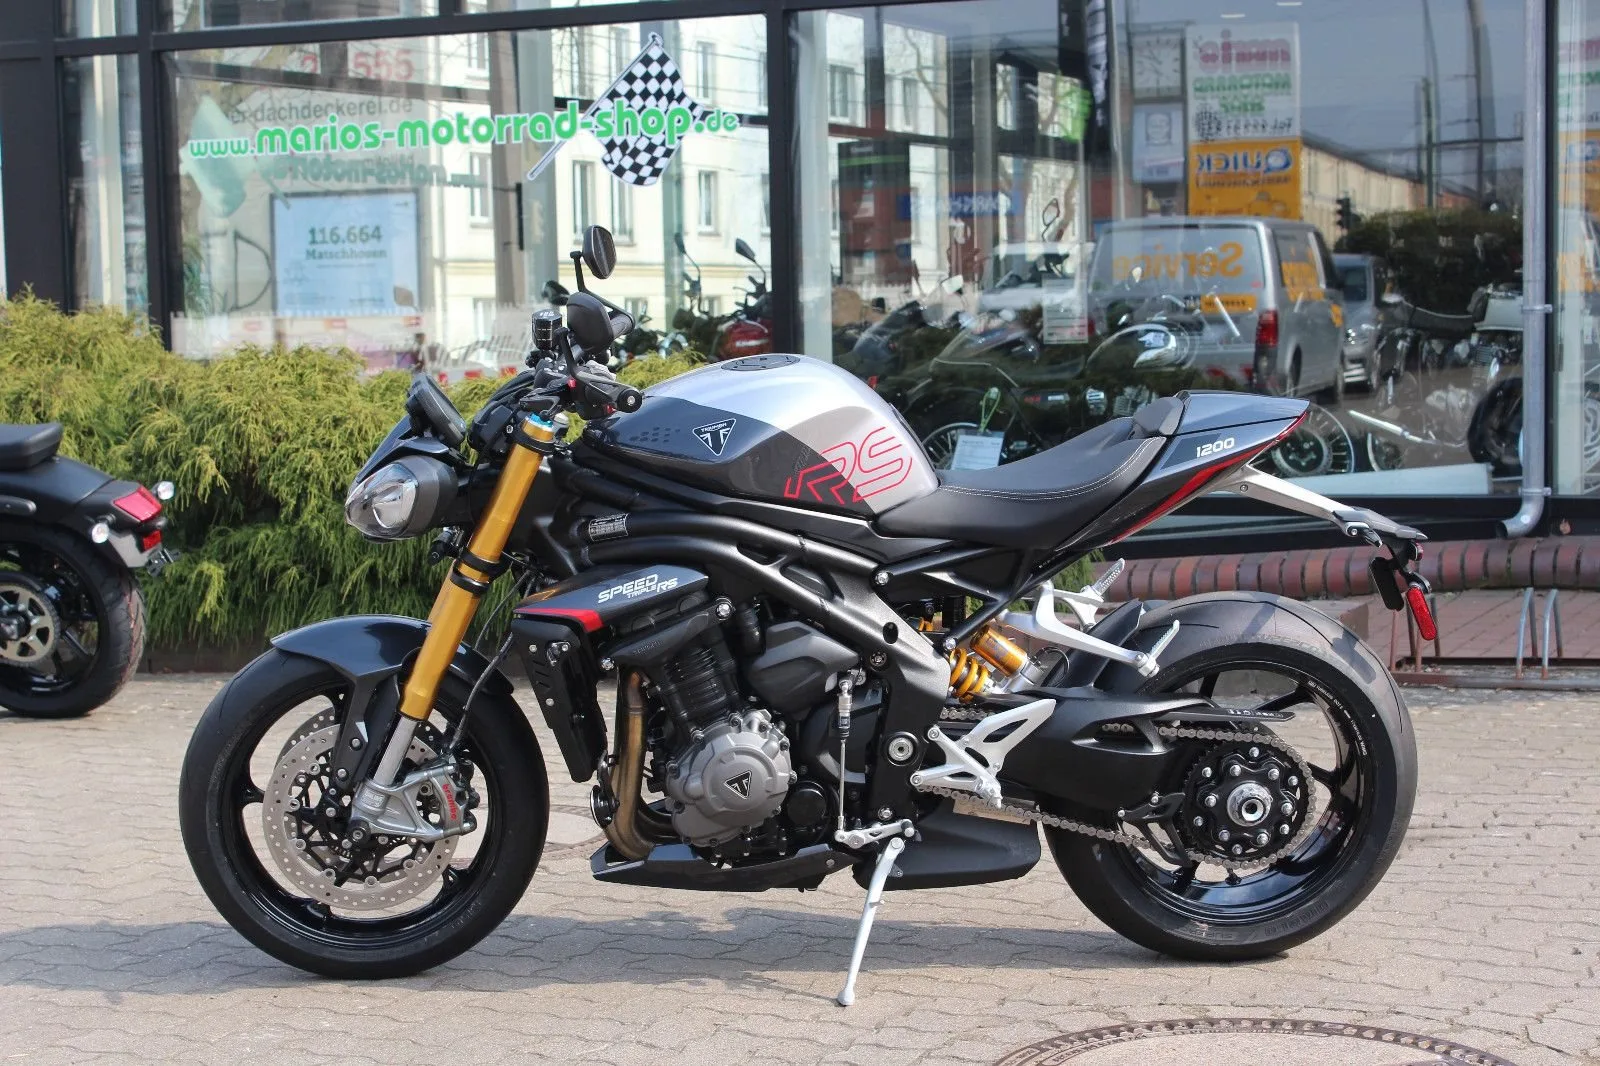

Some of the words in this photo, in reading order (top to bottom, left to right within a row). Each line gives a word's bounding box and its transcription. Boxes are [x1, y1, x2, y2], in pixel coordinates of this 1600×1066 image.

[188, 99, 740, 158] www.marios-motorrad-shop.de
[308, 225, 383, 245] 116.664
[1196, 437, 1235, 458] 1200
[597, 572, 659, 604] SPEED
[626, 583, 658, 599] TRIPLE
[657, 577, 679, 593] RS
